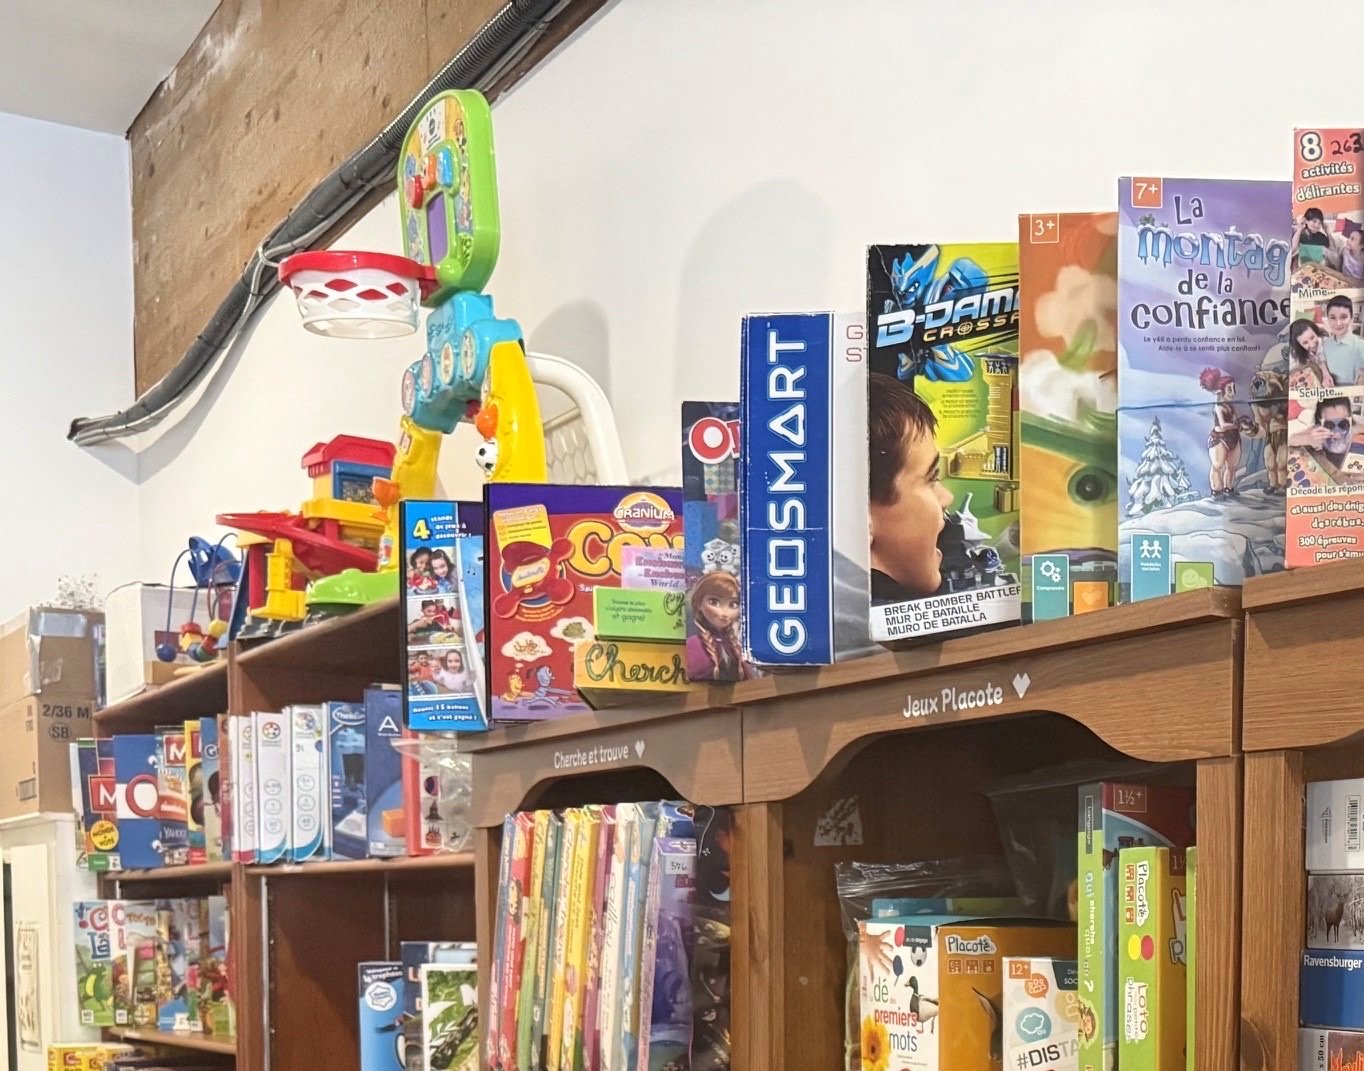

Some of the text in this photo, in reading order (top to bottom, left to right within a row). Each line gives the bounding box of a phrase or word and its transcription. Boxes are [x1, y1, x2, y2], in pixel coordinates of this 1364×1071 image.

[1301, 132, 1322, 161] 8
[1302, 162, 1354, 178] activités
[1136, 183, 1158, 200] 7+
[1296, 182, 1361, 202] délirantes
[1174, 196, 1203, 225] La
[1034, 216, 1056, 236] 3+
[1178, 269, 1233, 295] de la
[1131, 296, 1290, 329] confiance
[769, 330, 807, 656] GEOSMART
[1290, 486, 1336, 496] Décode les
[413, 519, 432, 541] 4
[1299, 536, 1357, 547] 300 épreuves
[1316, 550, 1336, 562] pour
[885, 595, 972, 616] BREAK BOMBER
[886, 604, 980, 626] MUR DE BATAILLE
[887, 612, 987, 636] MURO DE BATALLA
[42, 704, 77, 719] 2/36
[903, 682, 1003, 720] Jeux Placote
[52, 726, 70, 739] SB
[554, 745, 629, 769] Cherche et trouve
[947, 936, 992, 953] Placoté
[1011, 963, 1028, 975] 12+
[1303, 955, 1363, 969] Ravensburger
[874, 978, 889, 1002] dé
[875, 1009, 917, 1026] premiers
[1137, 984, 1148, 1034] Loto
[889, 1031, 917, 1052] mots
